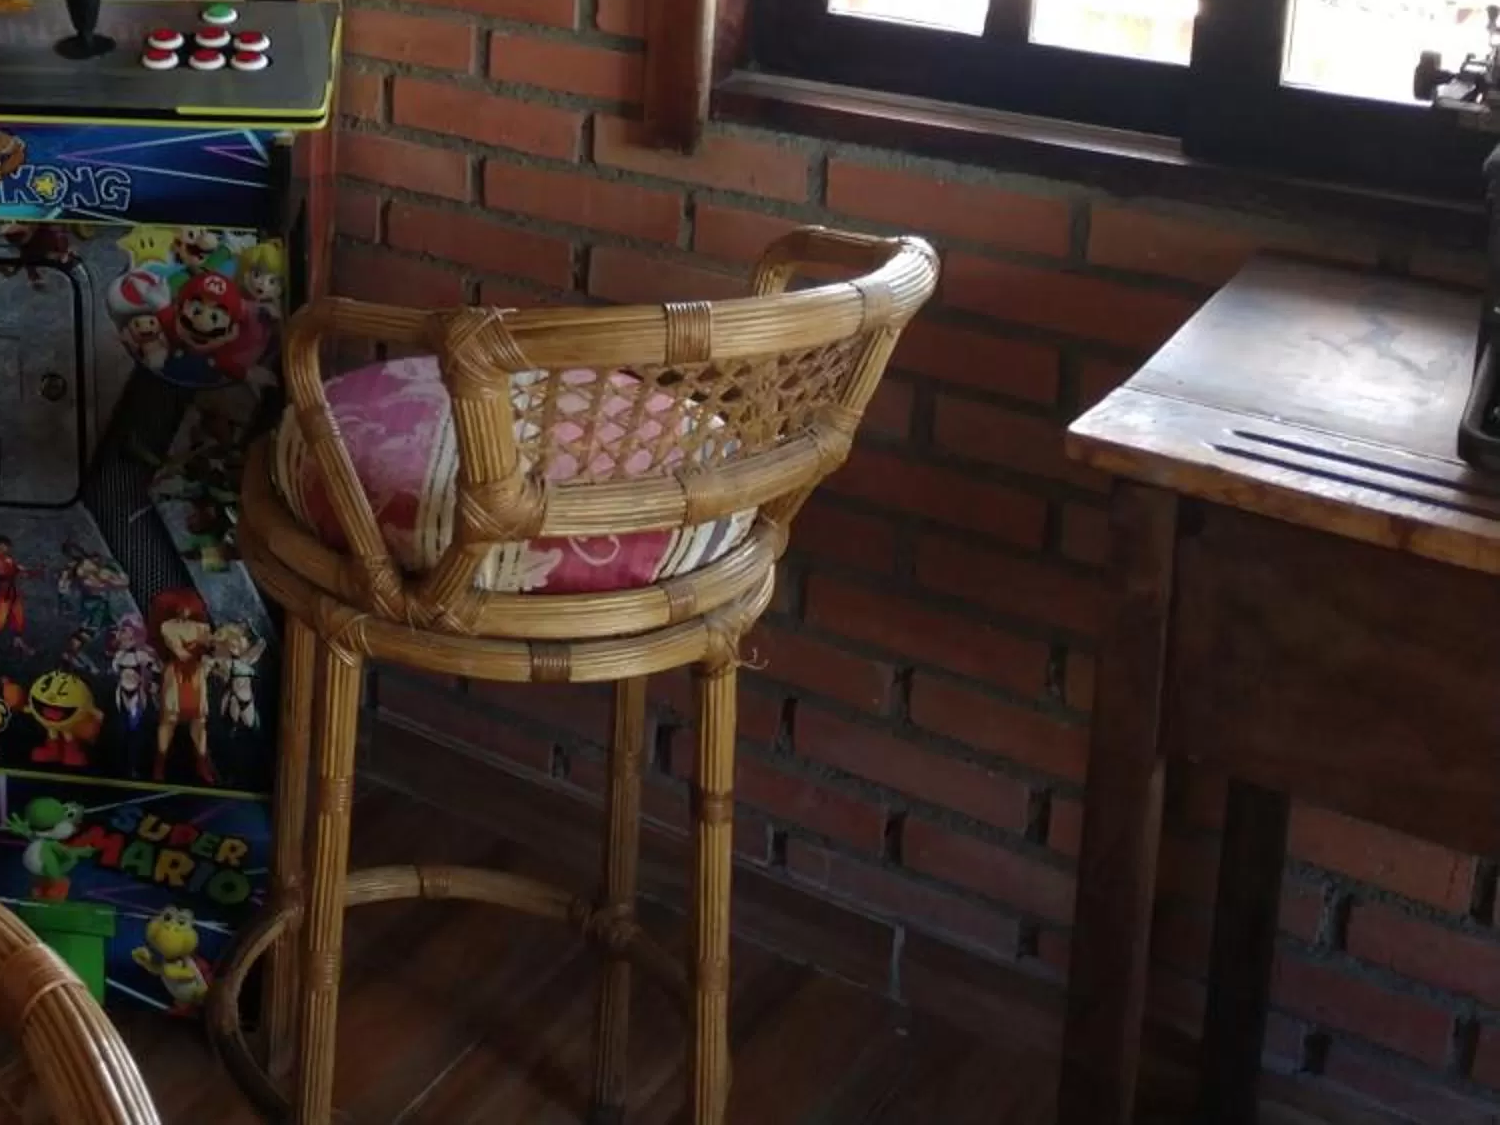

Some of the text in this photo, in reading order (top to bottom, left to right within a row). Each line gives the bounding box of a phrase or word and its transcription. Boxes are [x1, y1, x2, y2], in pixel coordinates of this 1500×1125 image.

[0, 164, 133, 212] KONG
[67, 824, 252, 905] MARIO
[111, 806, 249, 867] SUPER
